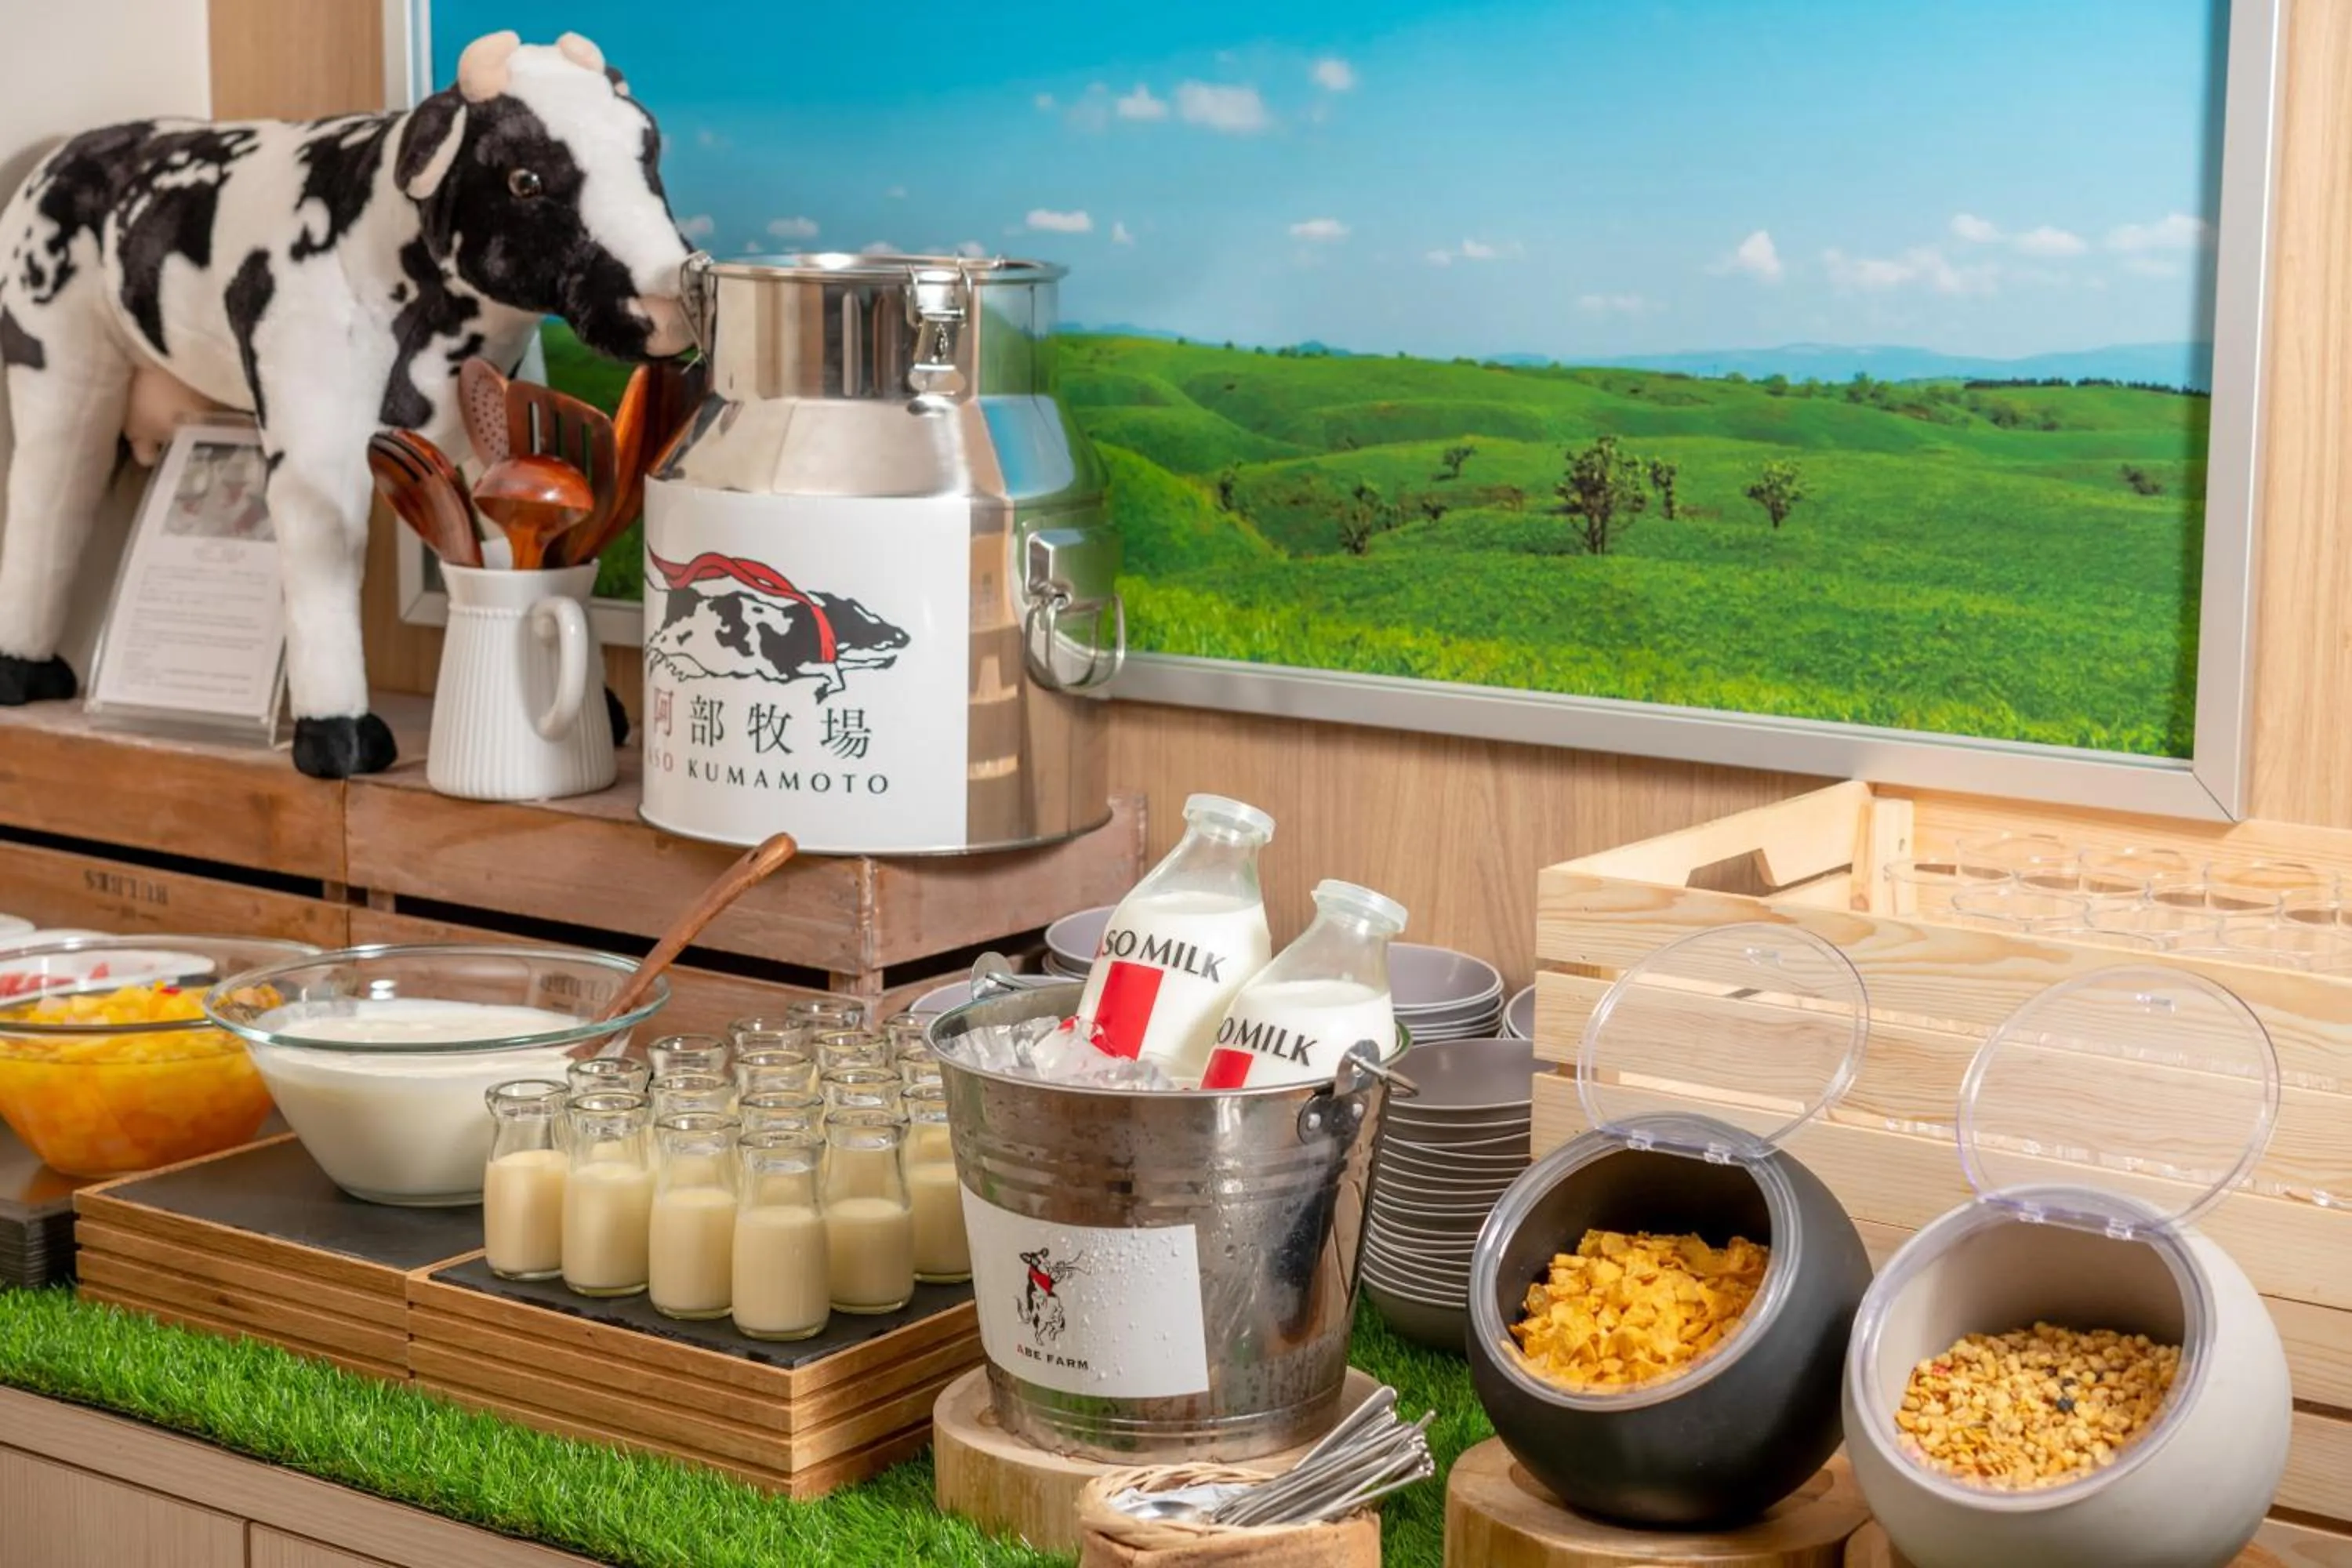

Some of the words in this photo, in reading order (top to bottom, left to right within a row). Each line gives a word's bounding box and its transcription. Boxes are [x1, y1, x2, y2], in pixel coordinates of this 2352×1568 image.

[688, 758, 888, 794] KUMAMOTO
[1095, 929, 1137, 957] SO
[1139, 934, 1227, 982] MILK
[1233, 1019, 1318, 1067] MILK
[1017, 1344, 1041, 1360] ABE
[1047, 1354, 1087, 1370] FARM
